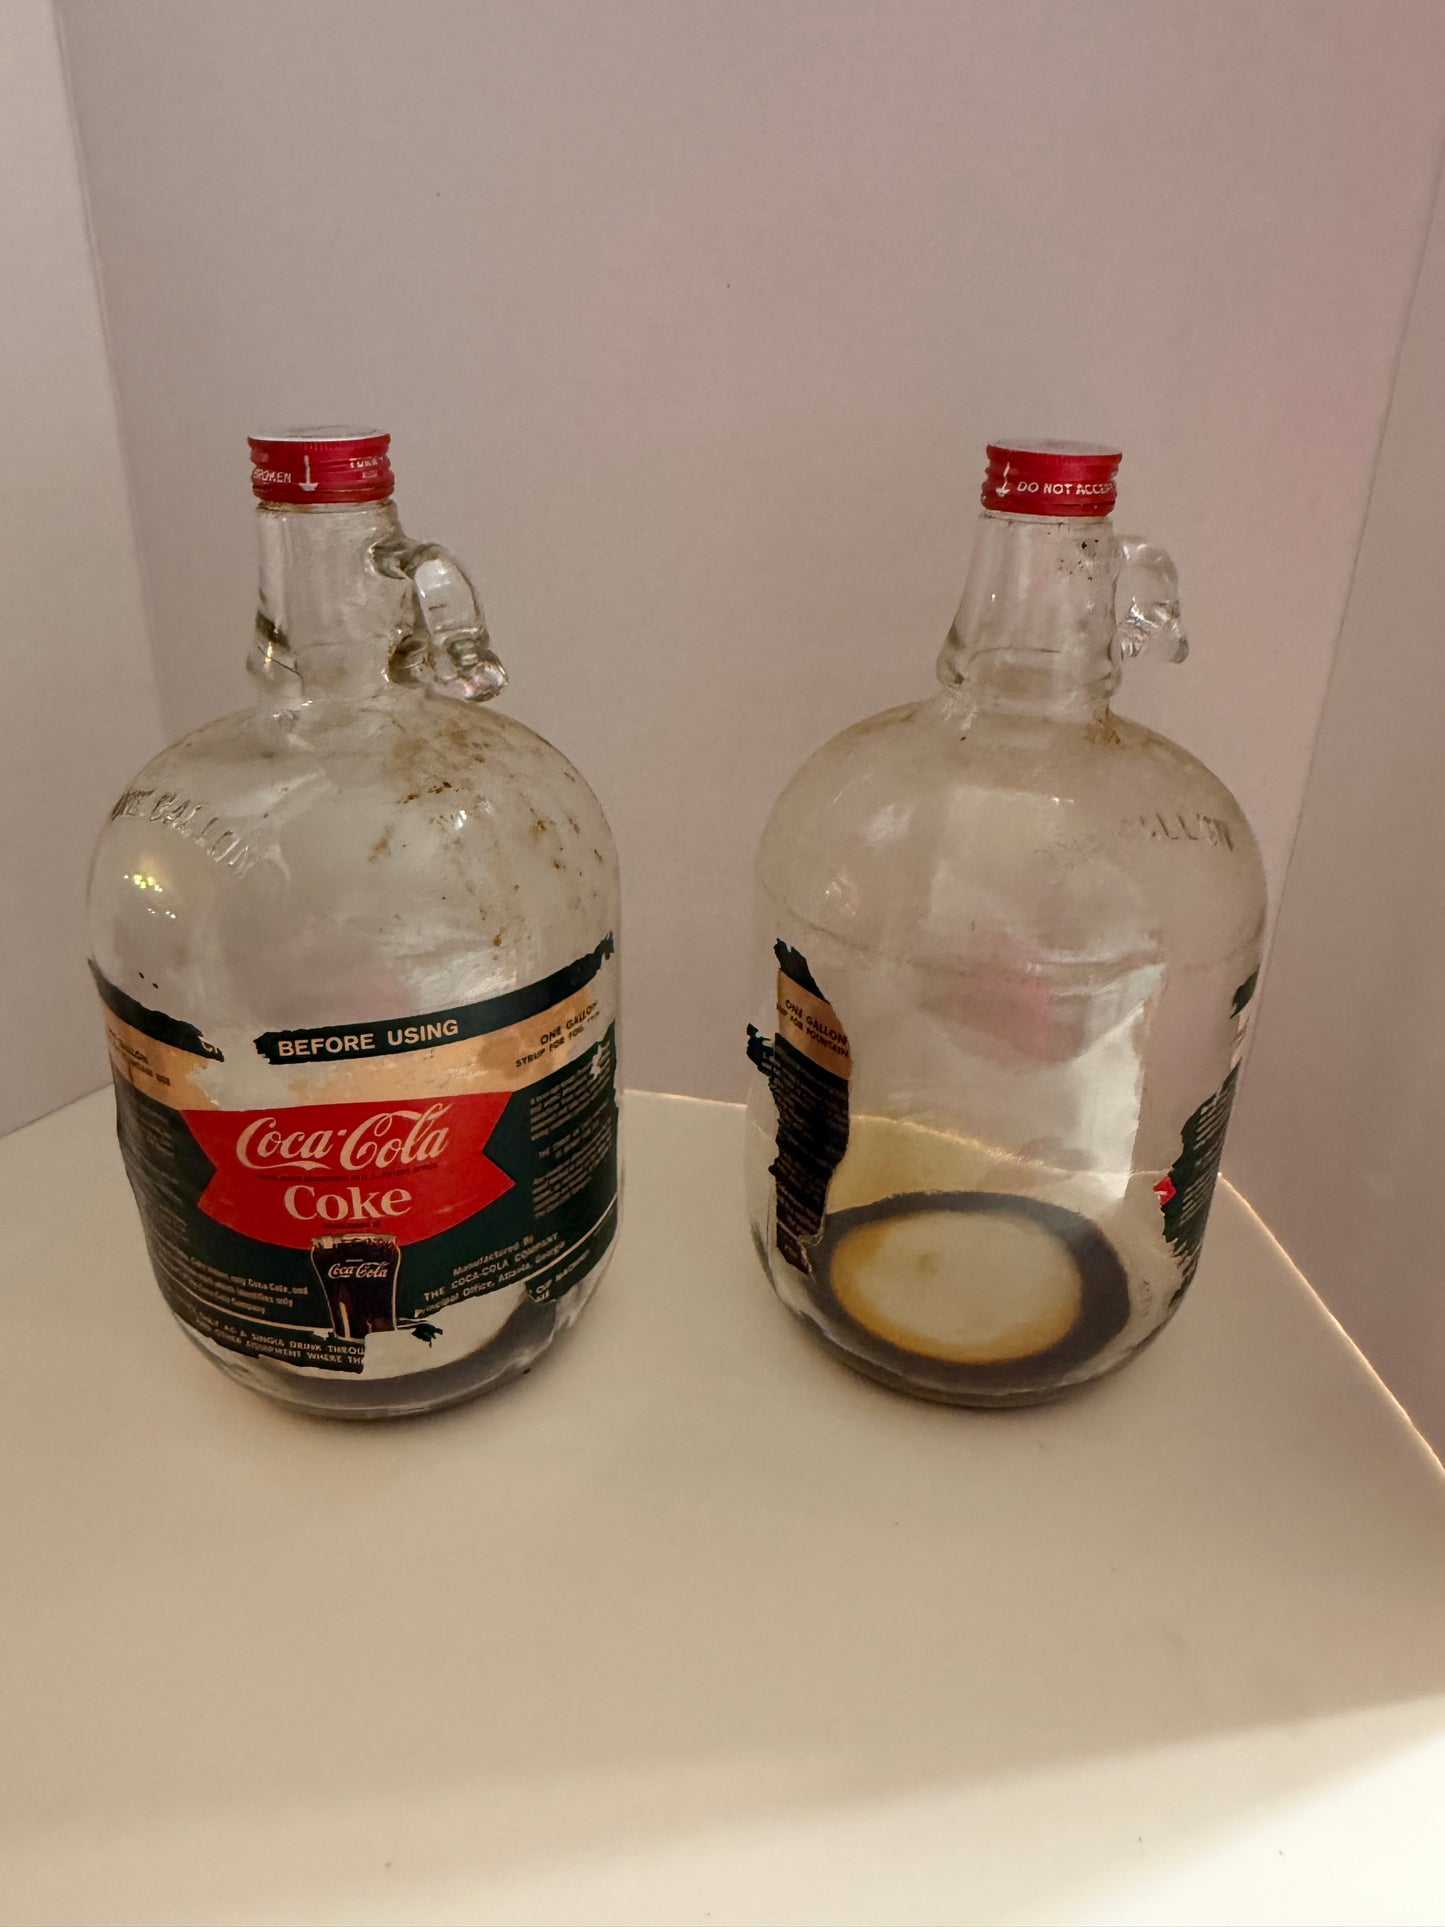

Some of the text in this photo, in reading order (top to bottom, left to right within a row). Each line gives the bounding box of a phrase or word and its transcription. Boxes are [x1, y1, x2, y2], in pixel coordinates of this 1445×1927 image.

[1016, 481, 1040, 493] DO
[1043, 482, 1074, 495] NOT
[277, 1018, 460, 1058] BEFORE USING
[805, 1015, 848, 1046] GALLON
[235, 1102, 455, 1172] Coca-Cola
[283, 1184, 413, 1222] Coke
[423, 1286, 447, 1302] THE
[451, 1259, 510, 1290] COCA-COLA
